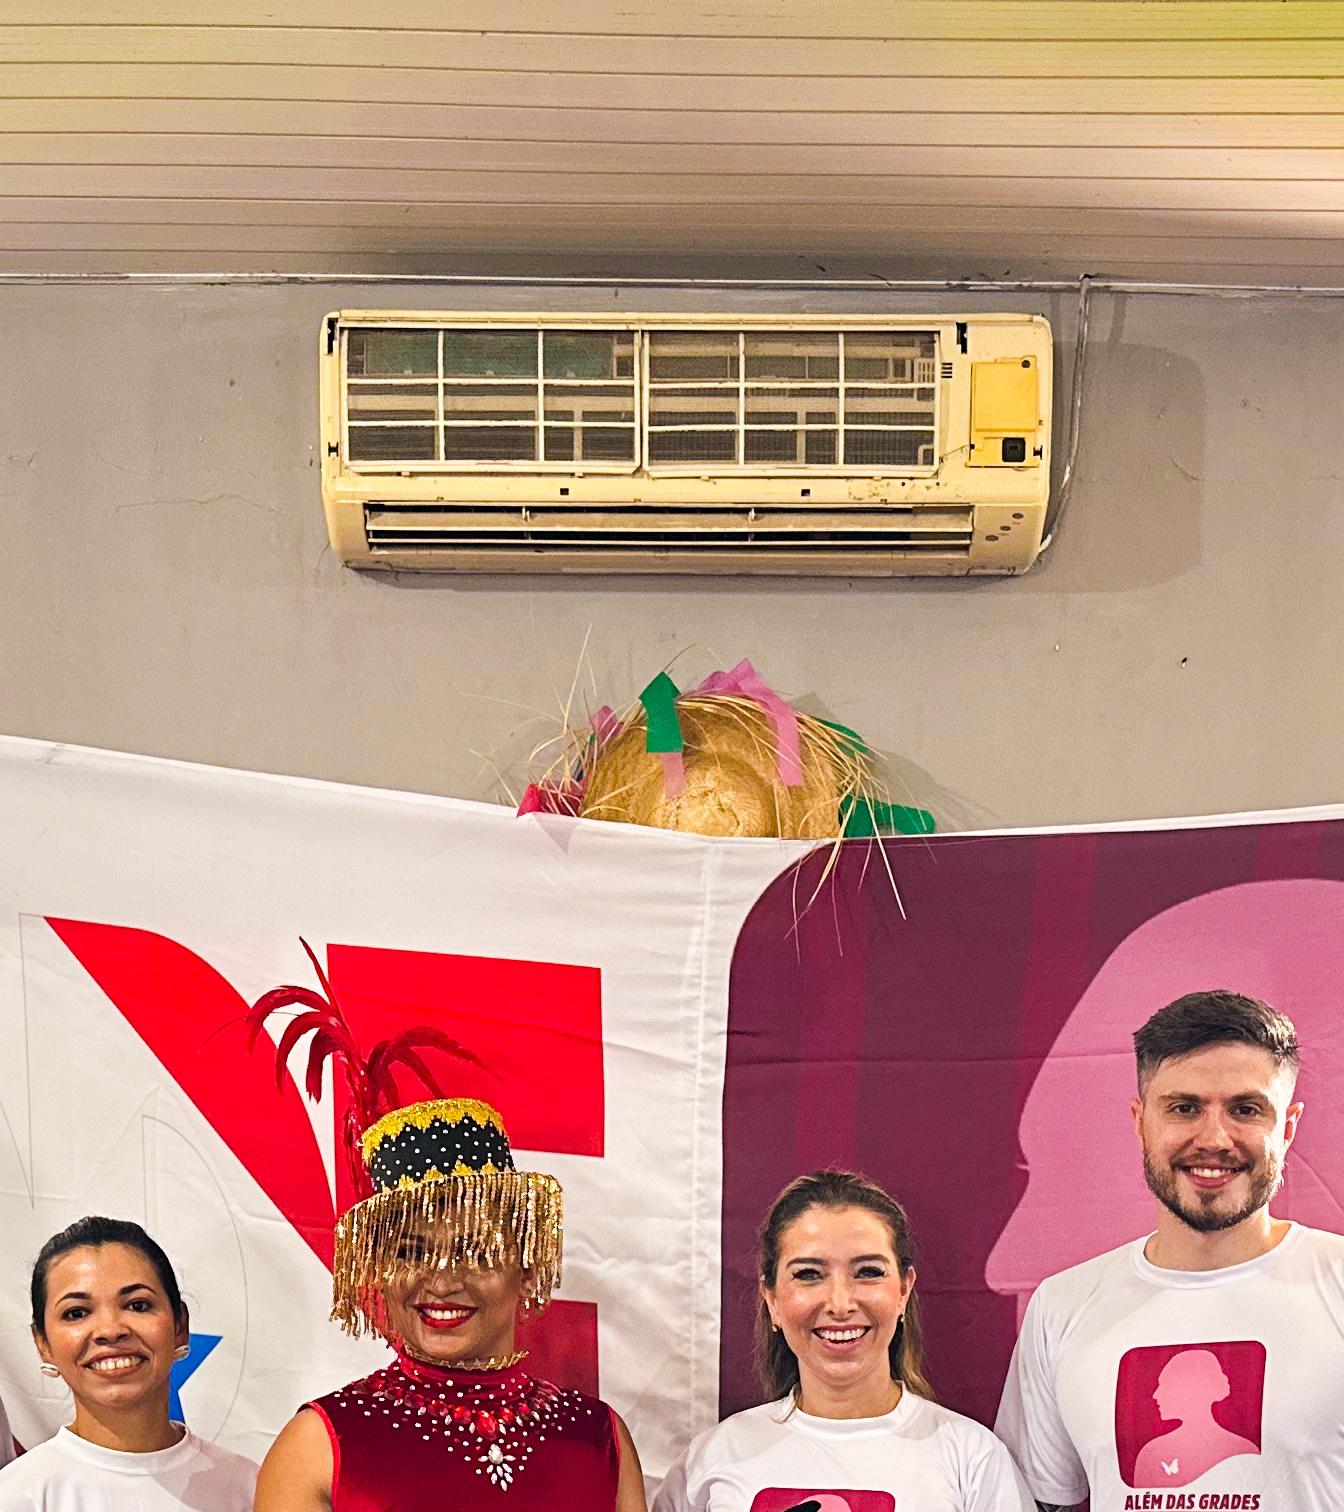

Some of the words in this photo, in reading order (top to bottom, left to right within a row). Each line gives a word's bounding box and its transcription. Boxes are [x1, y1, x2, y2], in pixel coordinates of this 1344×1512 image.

[1124, 1492, 1163, 1510] ALÉM
[1166, 1494, 1196, 1510] DAS
[1199, 1494, 1260, 1510] GRADES
